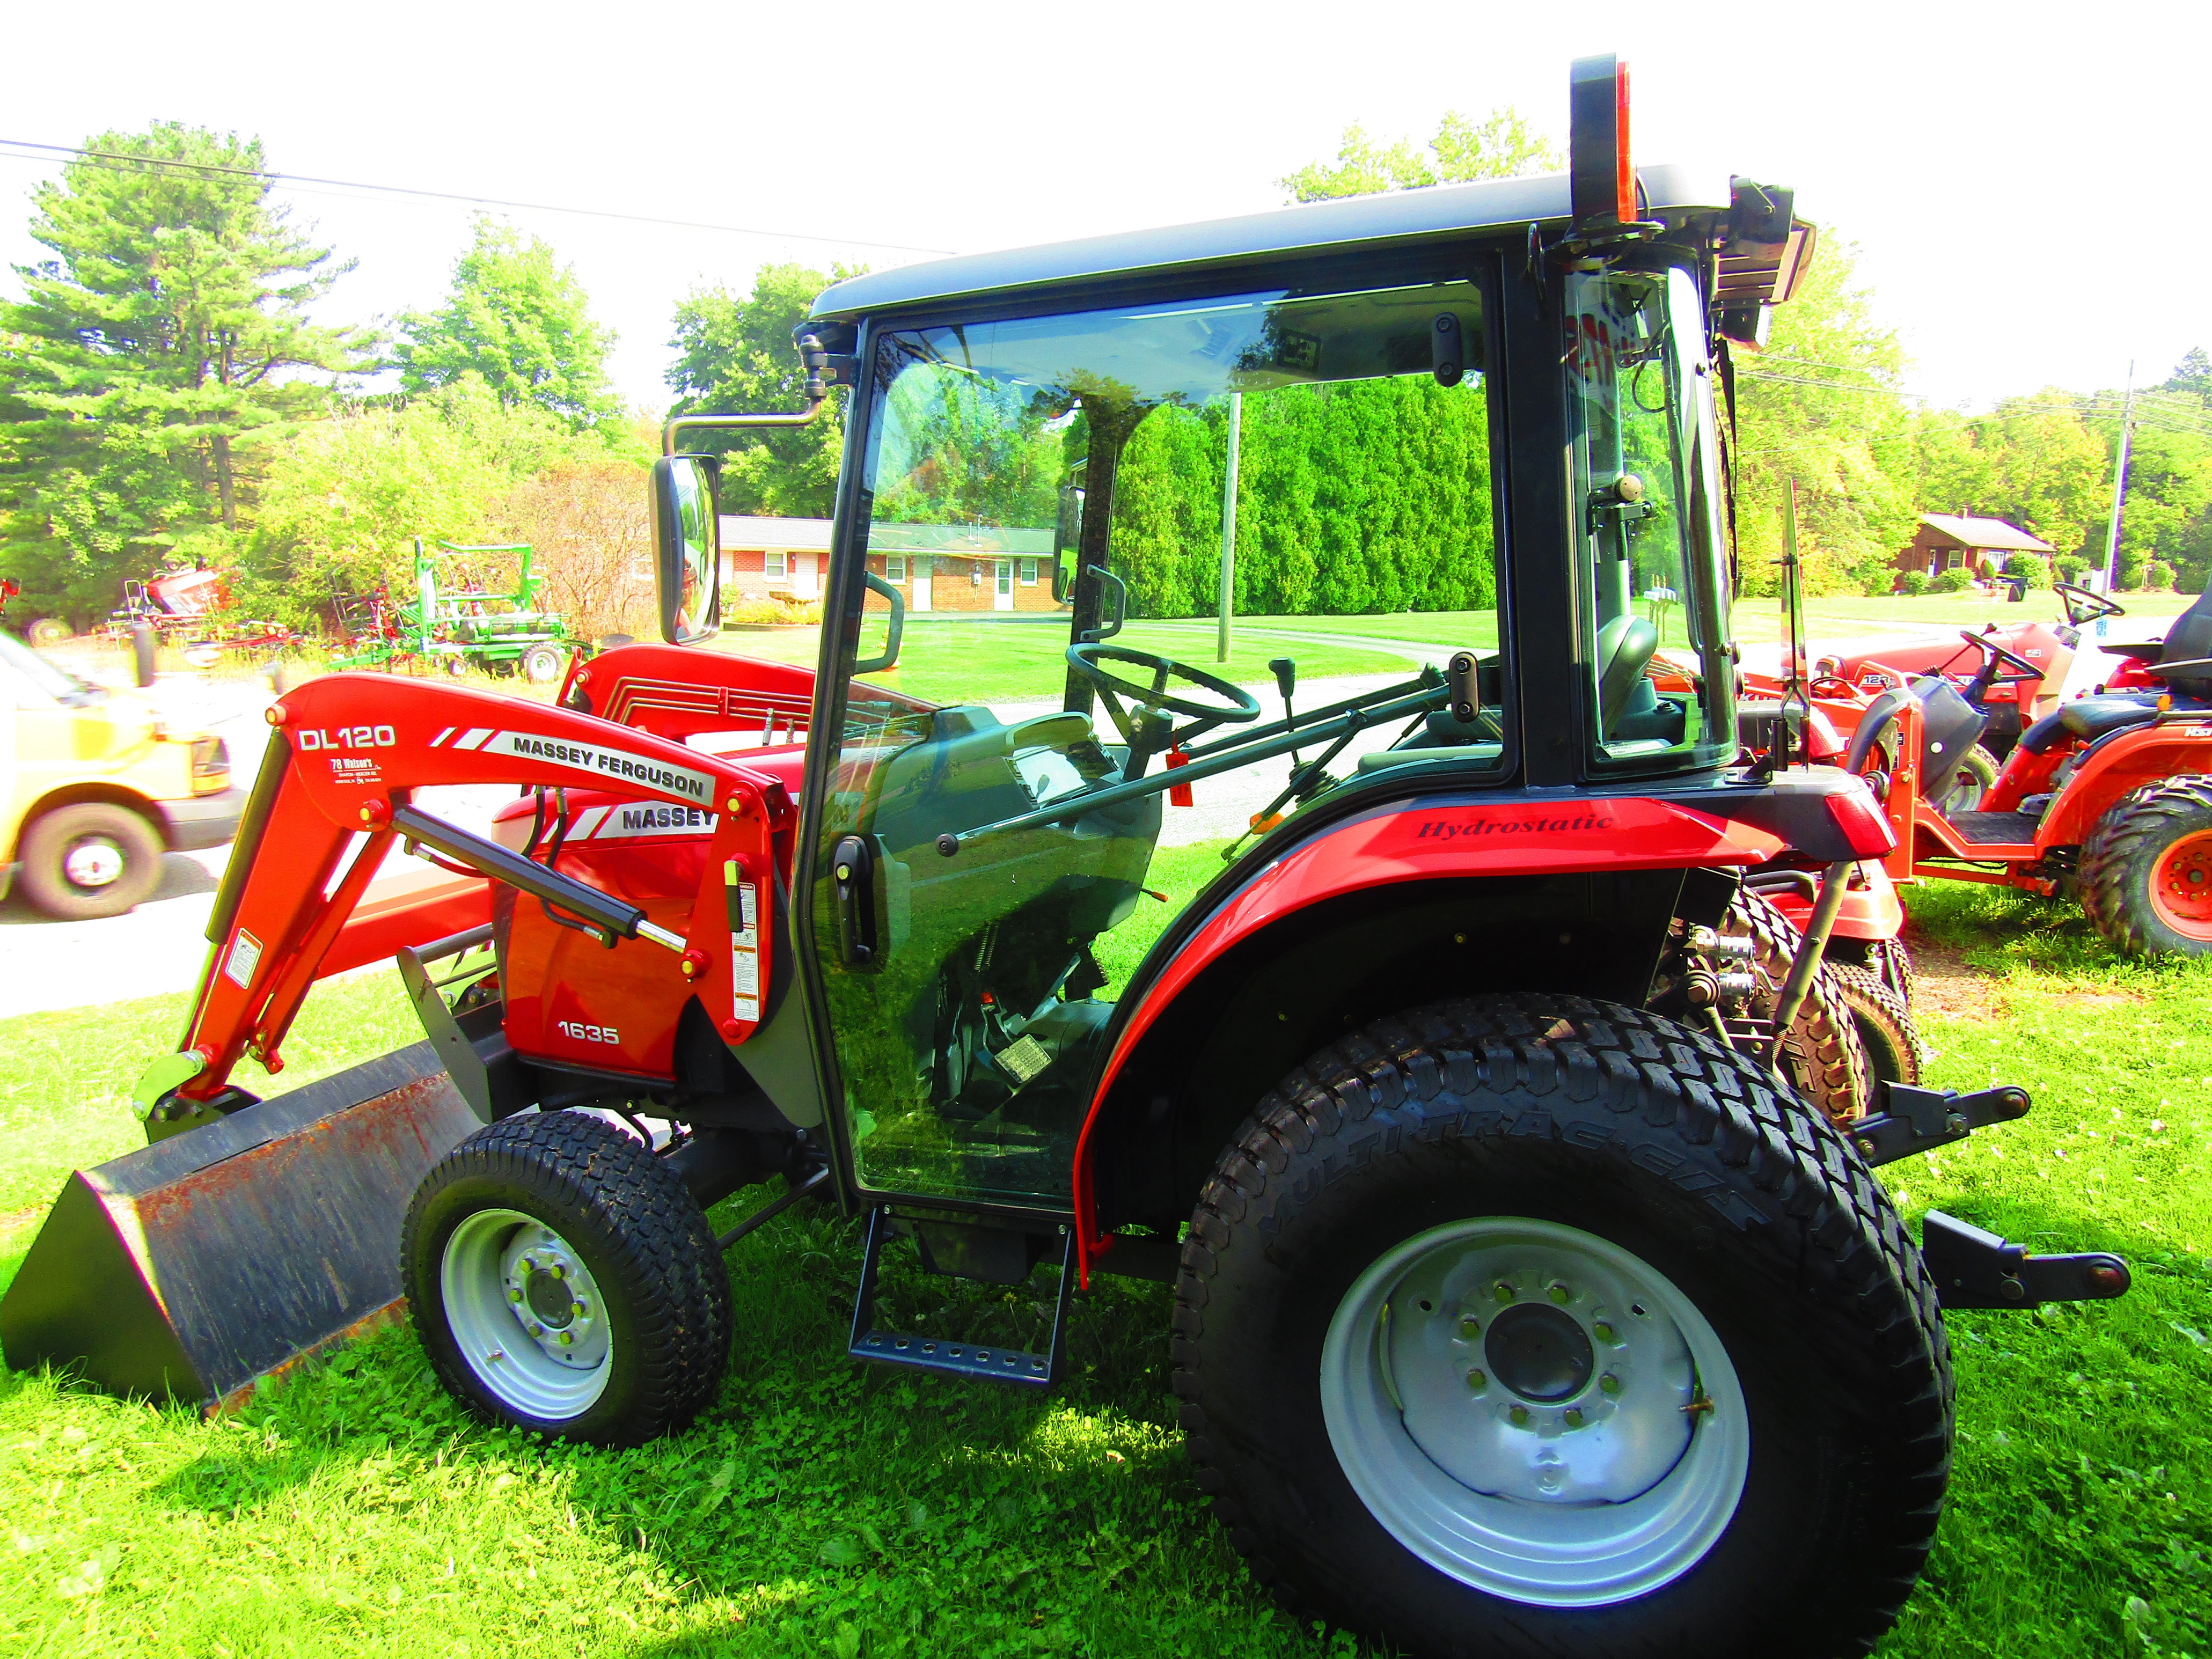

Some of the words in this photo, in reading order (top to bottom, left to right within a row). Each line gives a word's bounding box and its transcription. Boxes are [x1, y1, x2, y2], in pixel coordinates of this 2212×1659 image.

[331, 758, 342, 770] 78
[343, 758, 372, 768] Watson's
[514, 737, 594, 766] MASSEY
[598, 753, 705, 798] FERGUSON
[622, 806, 714, 830] MASSEY
[1417, 814, 1614, 841] Hydrostatic
[558, 1021, 620, 1045] 1635
[1419, 1109, 1616, 1150] TRAC
